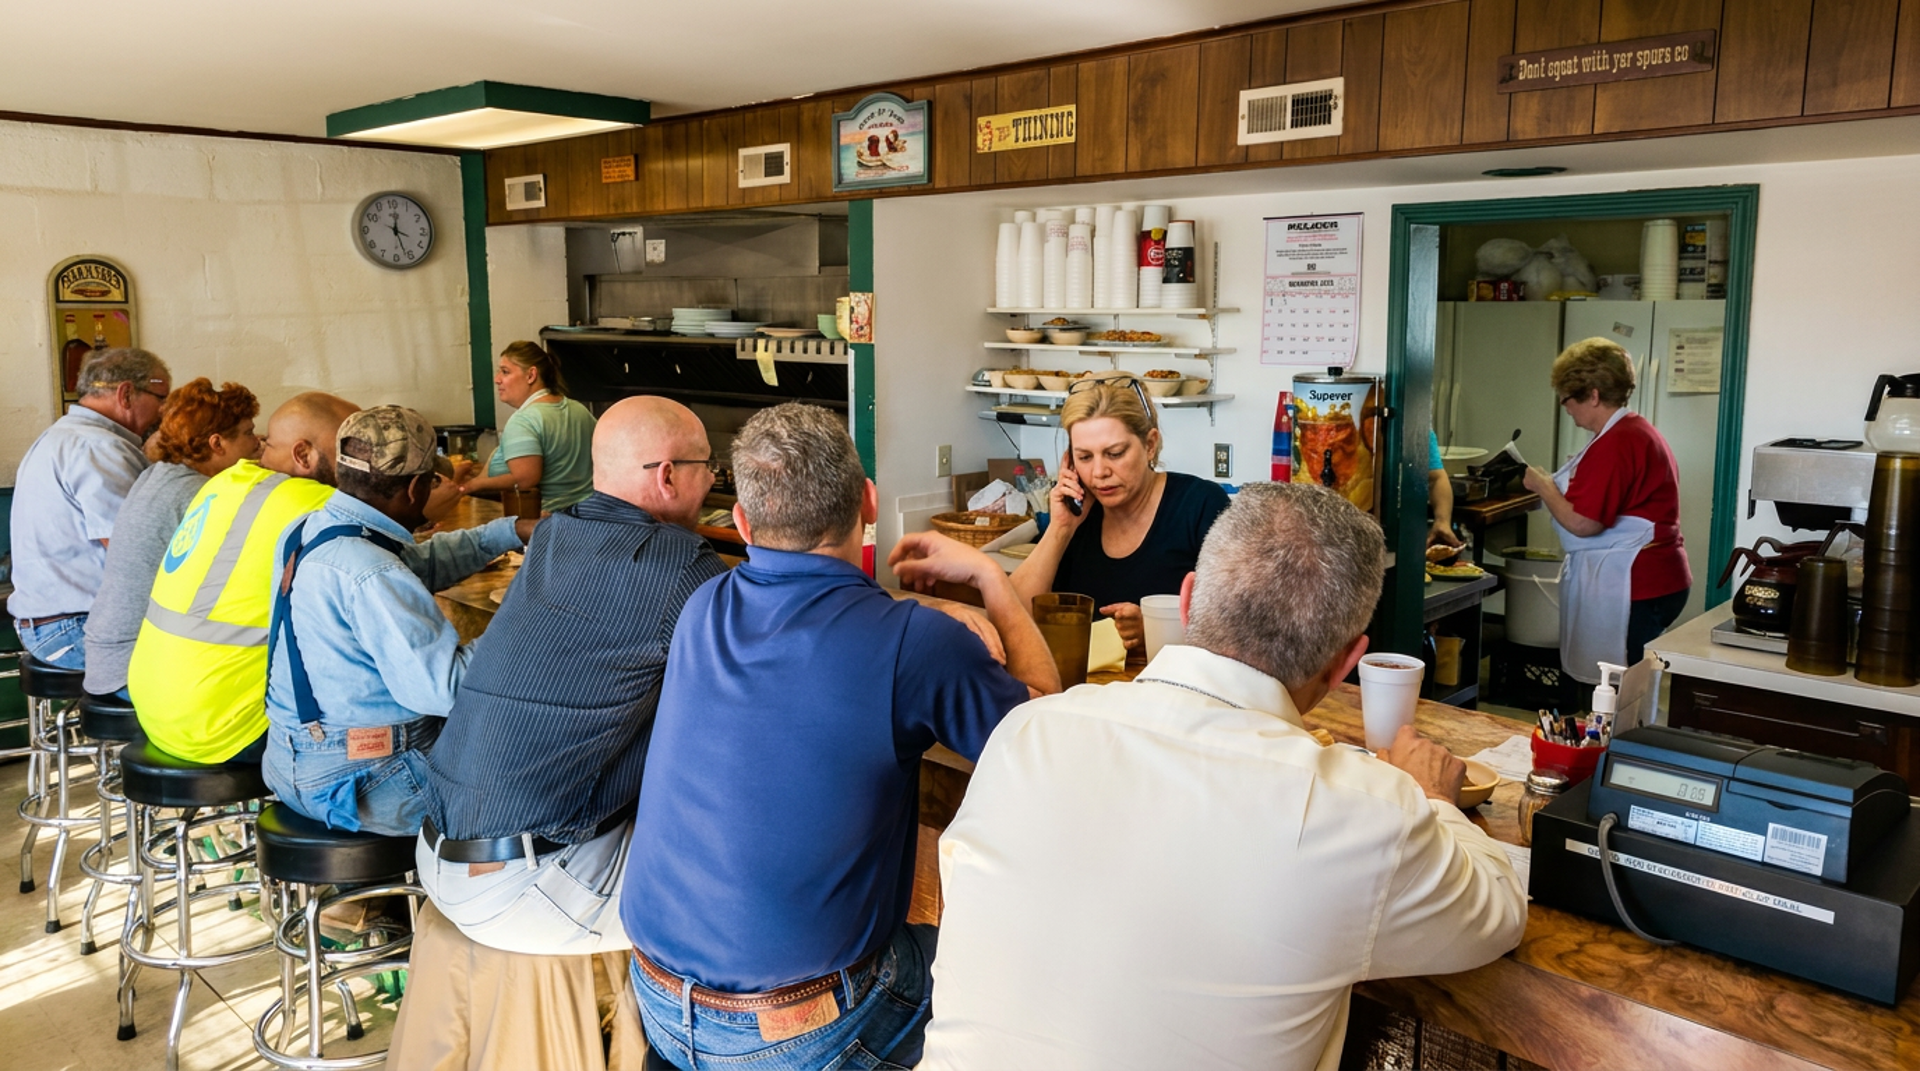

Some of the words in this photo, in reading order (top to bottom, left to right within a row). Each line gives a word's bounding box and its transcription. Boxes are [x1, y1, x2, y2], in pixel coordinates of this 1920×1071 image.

[1581, 49, 1611, 73] with
[1612, 51, 1634, 74] yer
[1309, 389, 1354, 402] Supever
